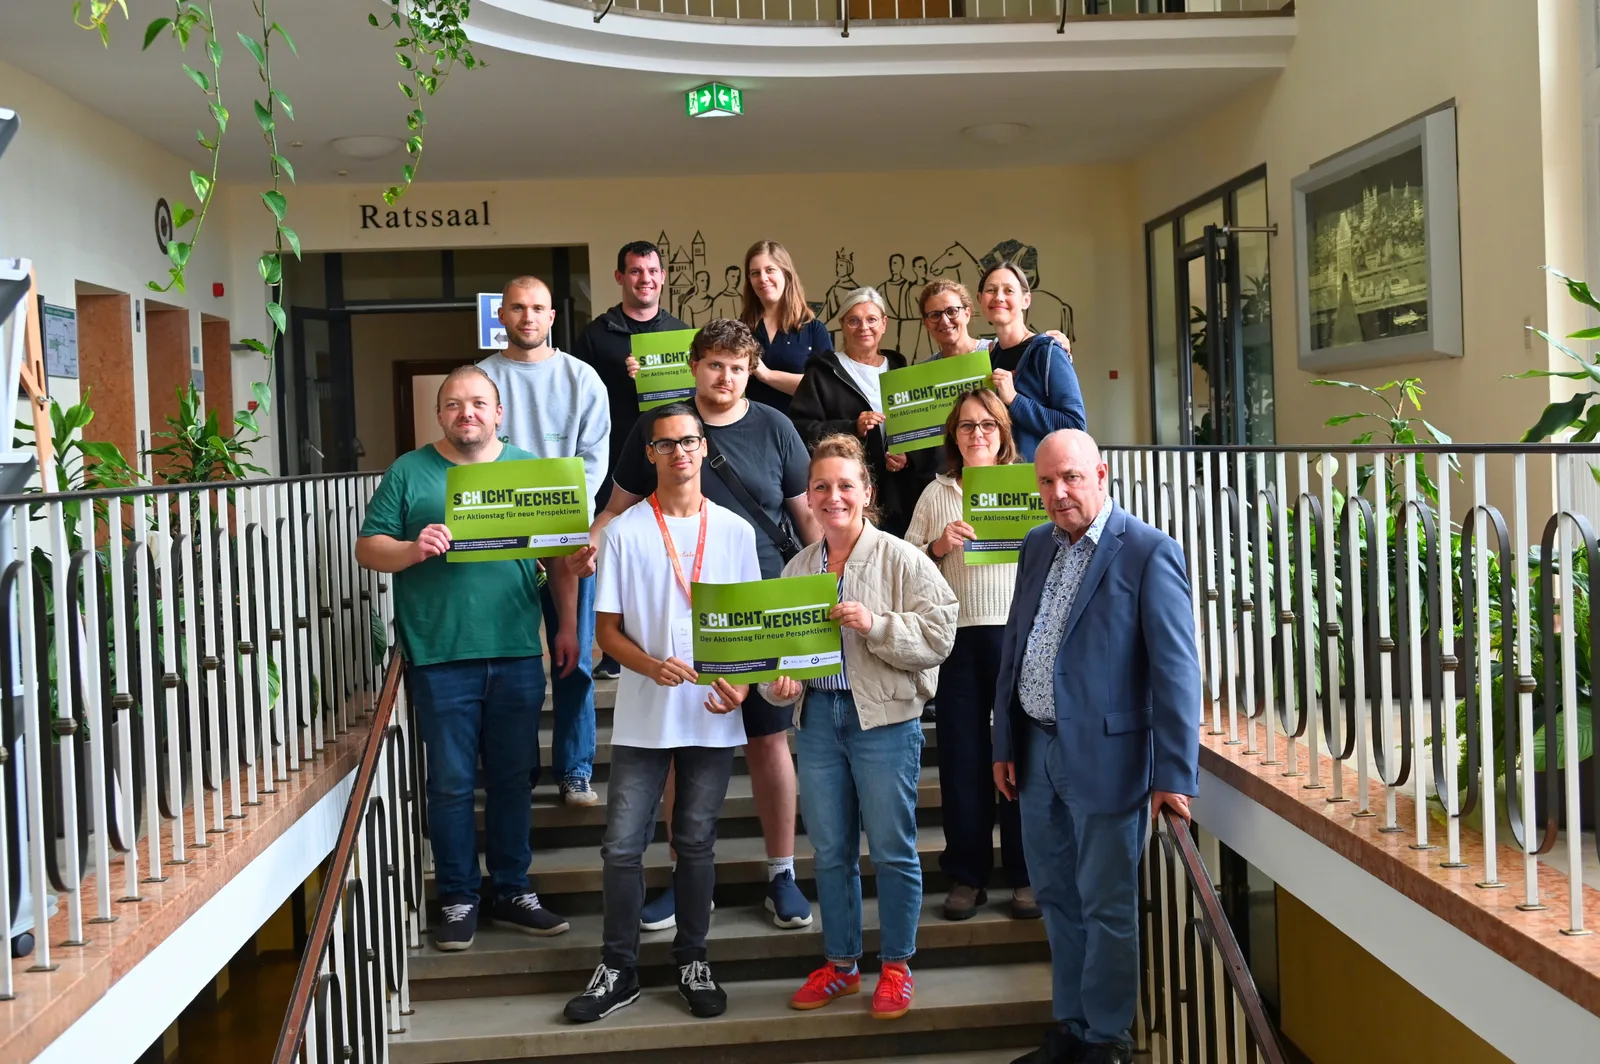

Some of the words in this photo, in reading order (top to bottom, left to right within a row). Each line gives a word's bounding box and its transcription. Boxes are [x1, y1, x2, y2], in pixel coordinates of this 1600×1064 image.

[359, 200, 491, 229] Ratssaal
[899, 407, 929, 417] Aktionstag
[938, 401, 952, 409] neue
[466, 512, 505, 520] Aktionstag
[536, 508, 581, 517] Perspektiven
[983, 514, 1020, 522] Aktionstag
[700, 635, 712, 643] Der
[713, 634, 753, 643] Aktionstag
[785, 627, 832, 637] Perspektiven
